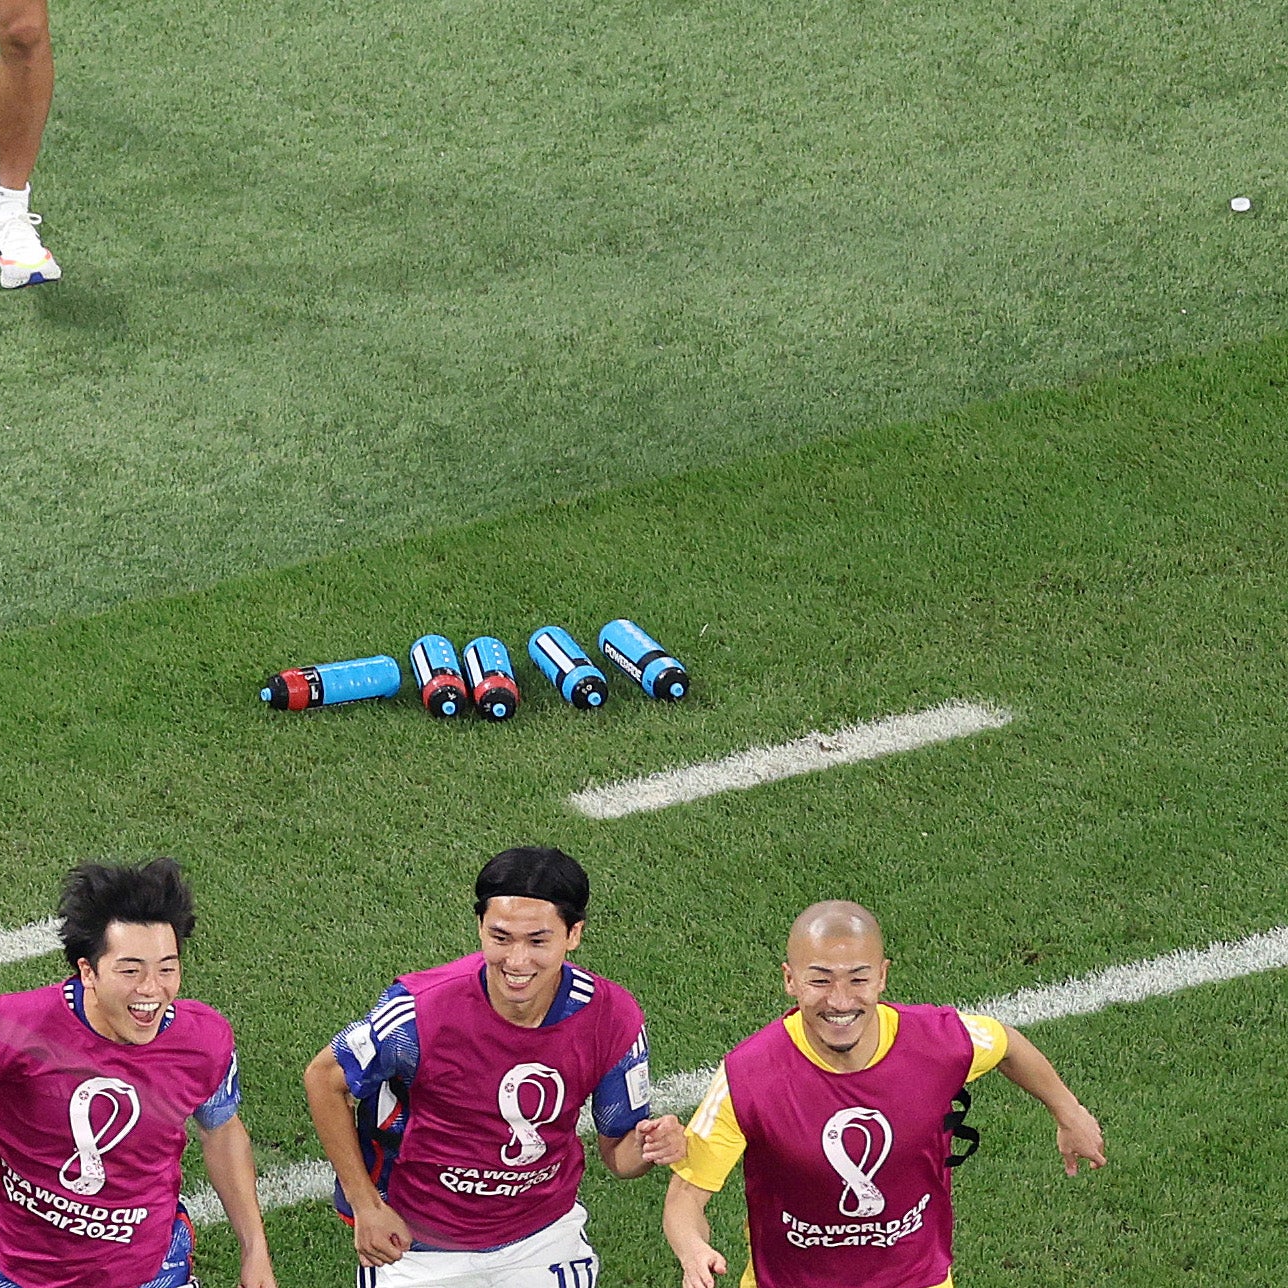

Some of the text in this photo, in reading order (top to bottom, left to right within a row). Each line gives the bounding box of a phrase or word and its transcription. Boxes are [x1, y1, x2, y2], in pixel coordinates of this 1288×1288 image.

[35, 1186, 109, 1221] WORLD
[111, 1207, 148, 1225] CUP
[782, 1193, 931, 1235] FIFA WORLD CUP
